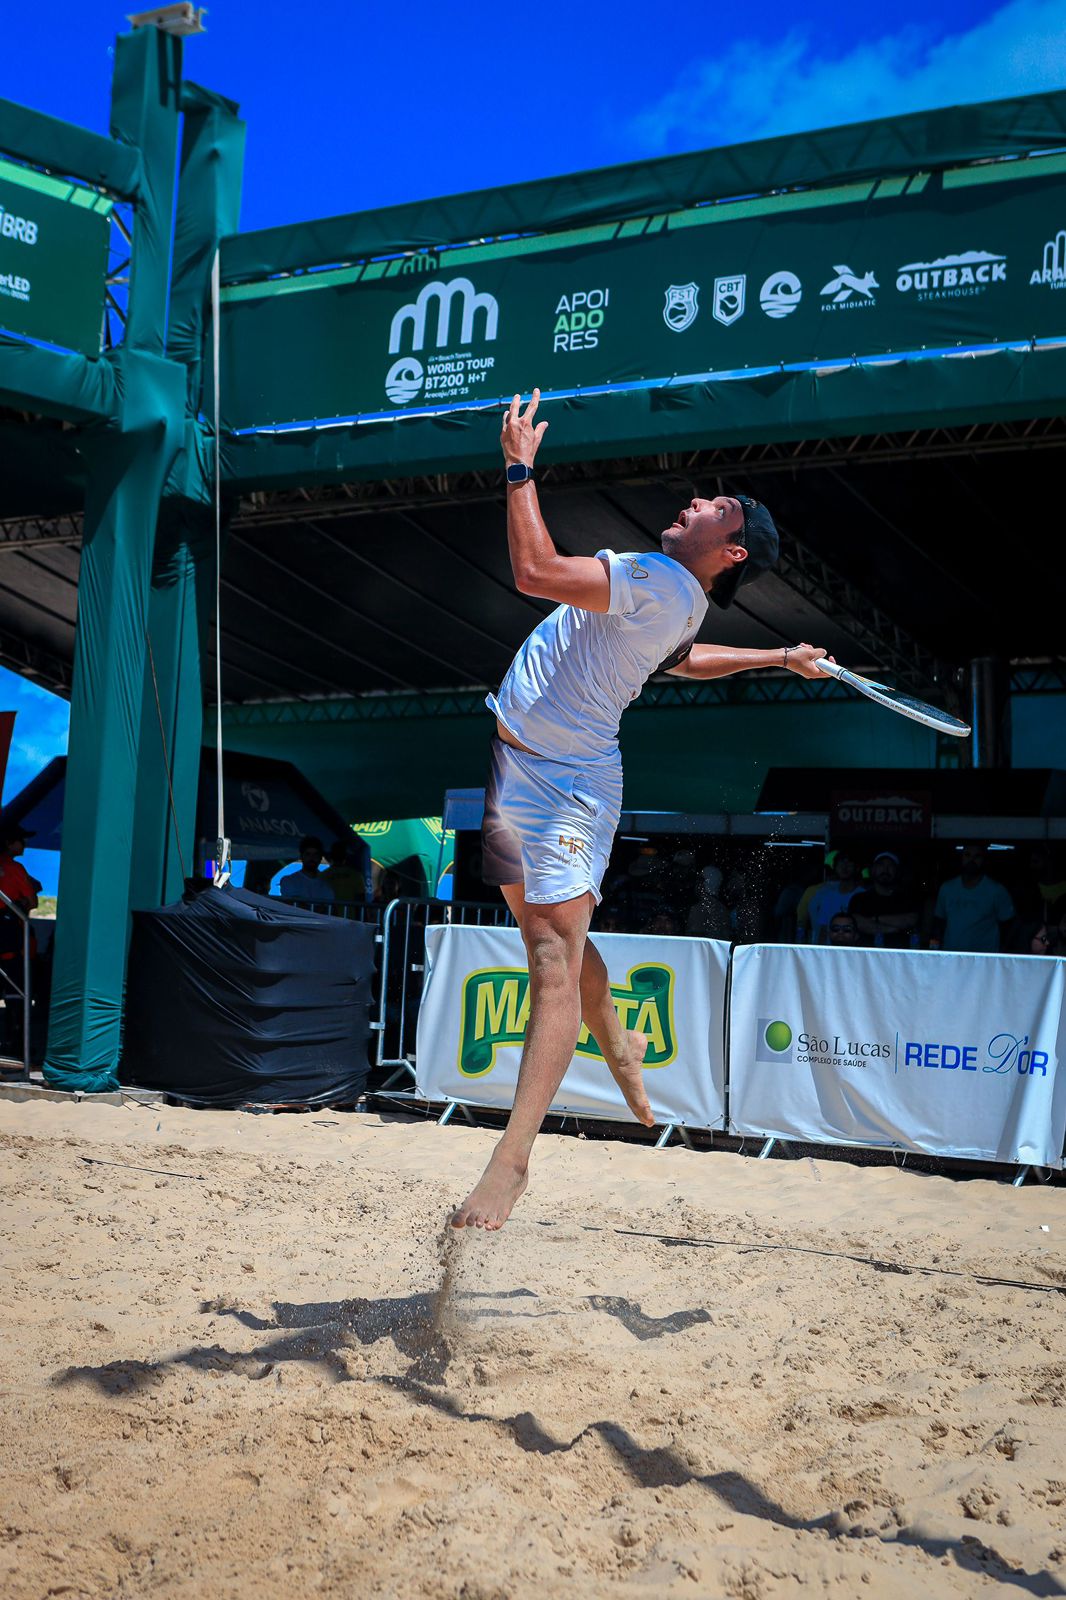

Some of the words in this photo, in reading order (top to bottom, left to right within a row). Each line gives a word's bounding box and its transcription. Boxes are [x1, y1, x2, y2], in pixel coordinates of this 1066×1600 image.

[719, 281, 741, 293] CBT
[895, 263, 1007, 292] OUTBACK
[555, 288, 609, 315] APOI
[671, 289, 692, 301] FST
[917, 287, 981, 301] STEAKHOUSE
[821, 304, 837, 312] FOX
[839, 299, 876, 310] MIDIATIC
[554, 309, 605, 334] ADO
[553, 330, 599, 352] RES
[427, 361, 464, 375] WORLD
[466, 357, 495, 370] TOUR
[424, 373, 465, 390] BT200
[467, 371, 487, 384] H+T
[838, 807, 923, 823] OUTBACK
[239, 816, 306, 838] ANASOL
[475, 979, 667, 1054] MTÁ
[797, 1033, 829, 1053] São
[833, 1036, 891, 1059] Lucas
[832, 1058, 842, 1066] DE
[843, 1057, 867, 1068] SAÚDE
[905, 1042, 978, 1072] REDE
